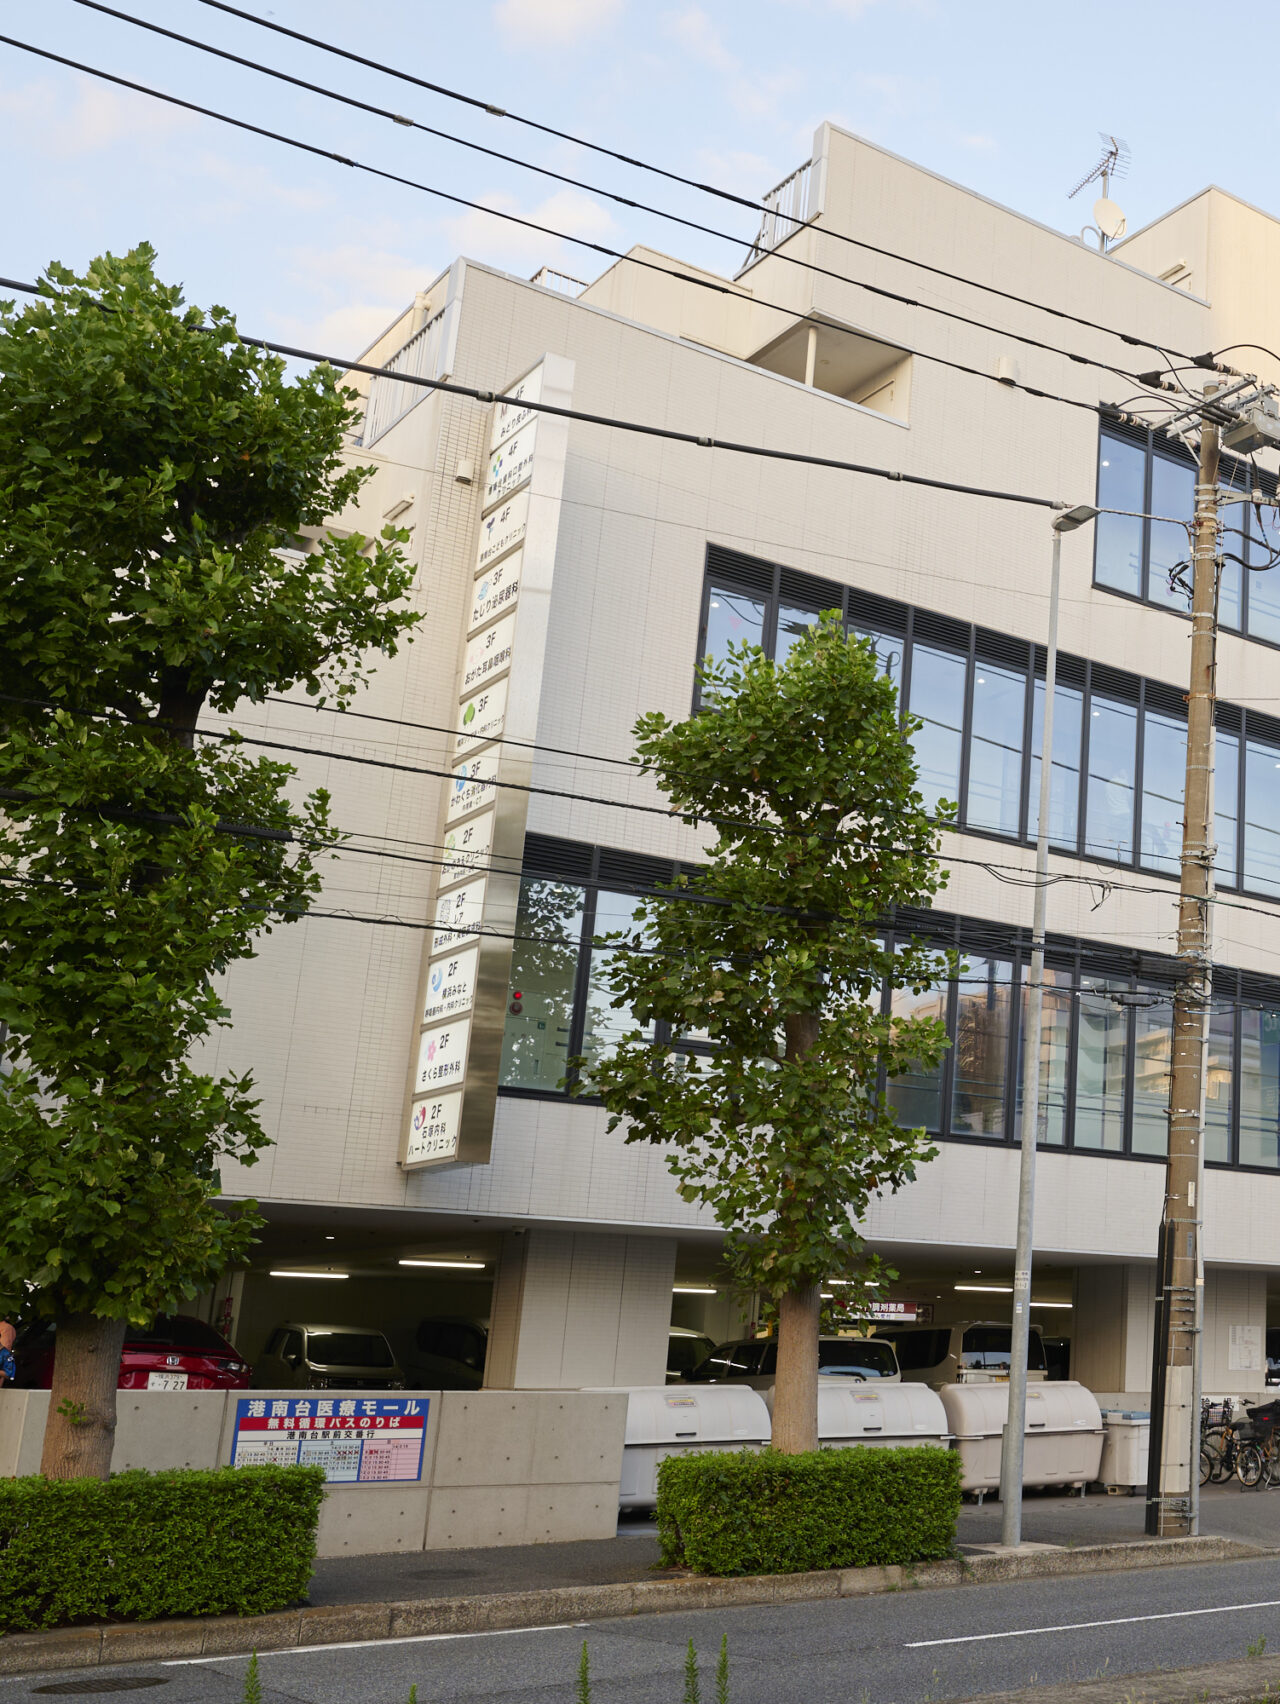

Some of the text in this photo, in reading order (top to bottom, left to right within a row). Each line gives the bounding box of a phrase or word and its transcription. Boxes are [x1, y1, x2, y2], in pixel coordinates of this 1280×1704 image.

[508, 440, 518, 456] 4F
[500, 506, 511, 522] 4F
[493, 567, 504, 586] 3F
[485, 631, 497, 649] 3F
[478, 694, 489, 713] 3F
[462, 827, 474, 845] 2F
[455, 892, 467, 909] 2F
[448, 961, 459, 978] 2F
[439, 1033, 450, 1050] 2F
[421, 1059, 461, 1083] さくら整形外科
[430, 1103, 443, 1120] 2F
[421, 1122, 447, 1140] 石塚内科
[408, 1134, 457, 1156] ハートクリニック
[247, 1400, 420, 1417] 港南台医療モール
[267, 1417, 401, 1430] 無料循環バスのりば
[286, 1430, 375, 1440] 港南台駅前交番行
